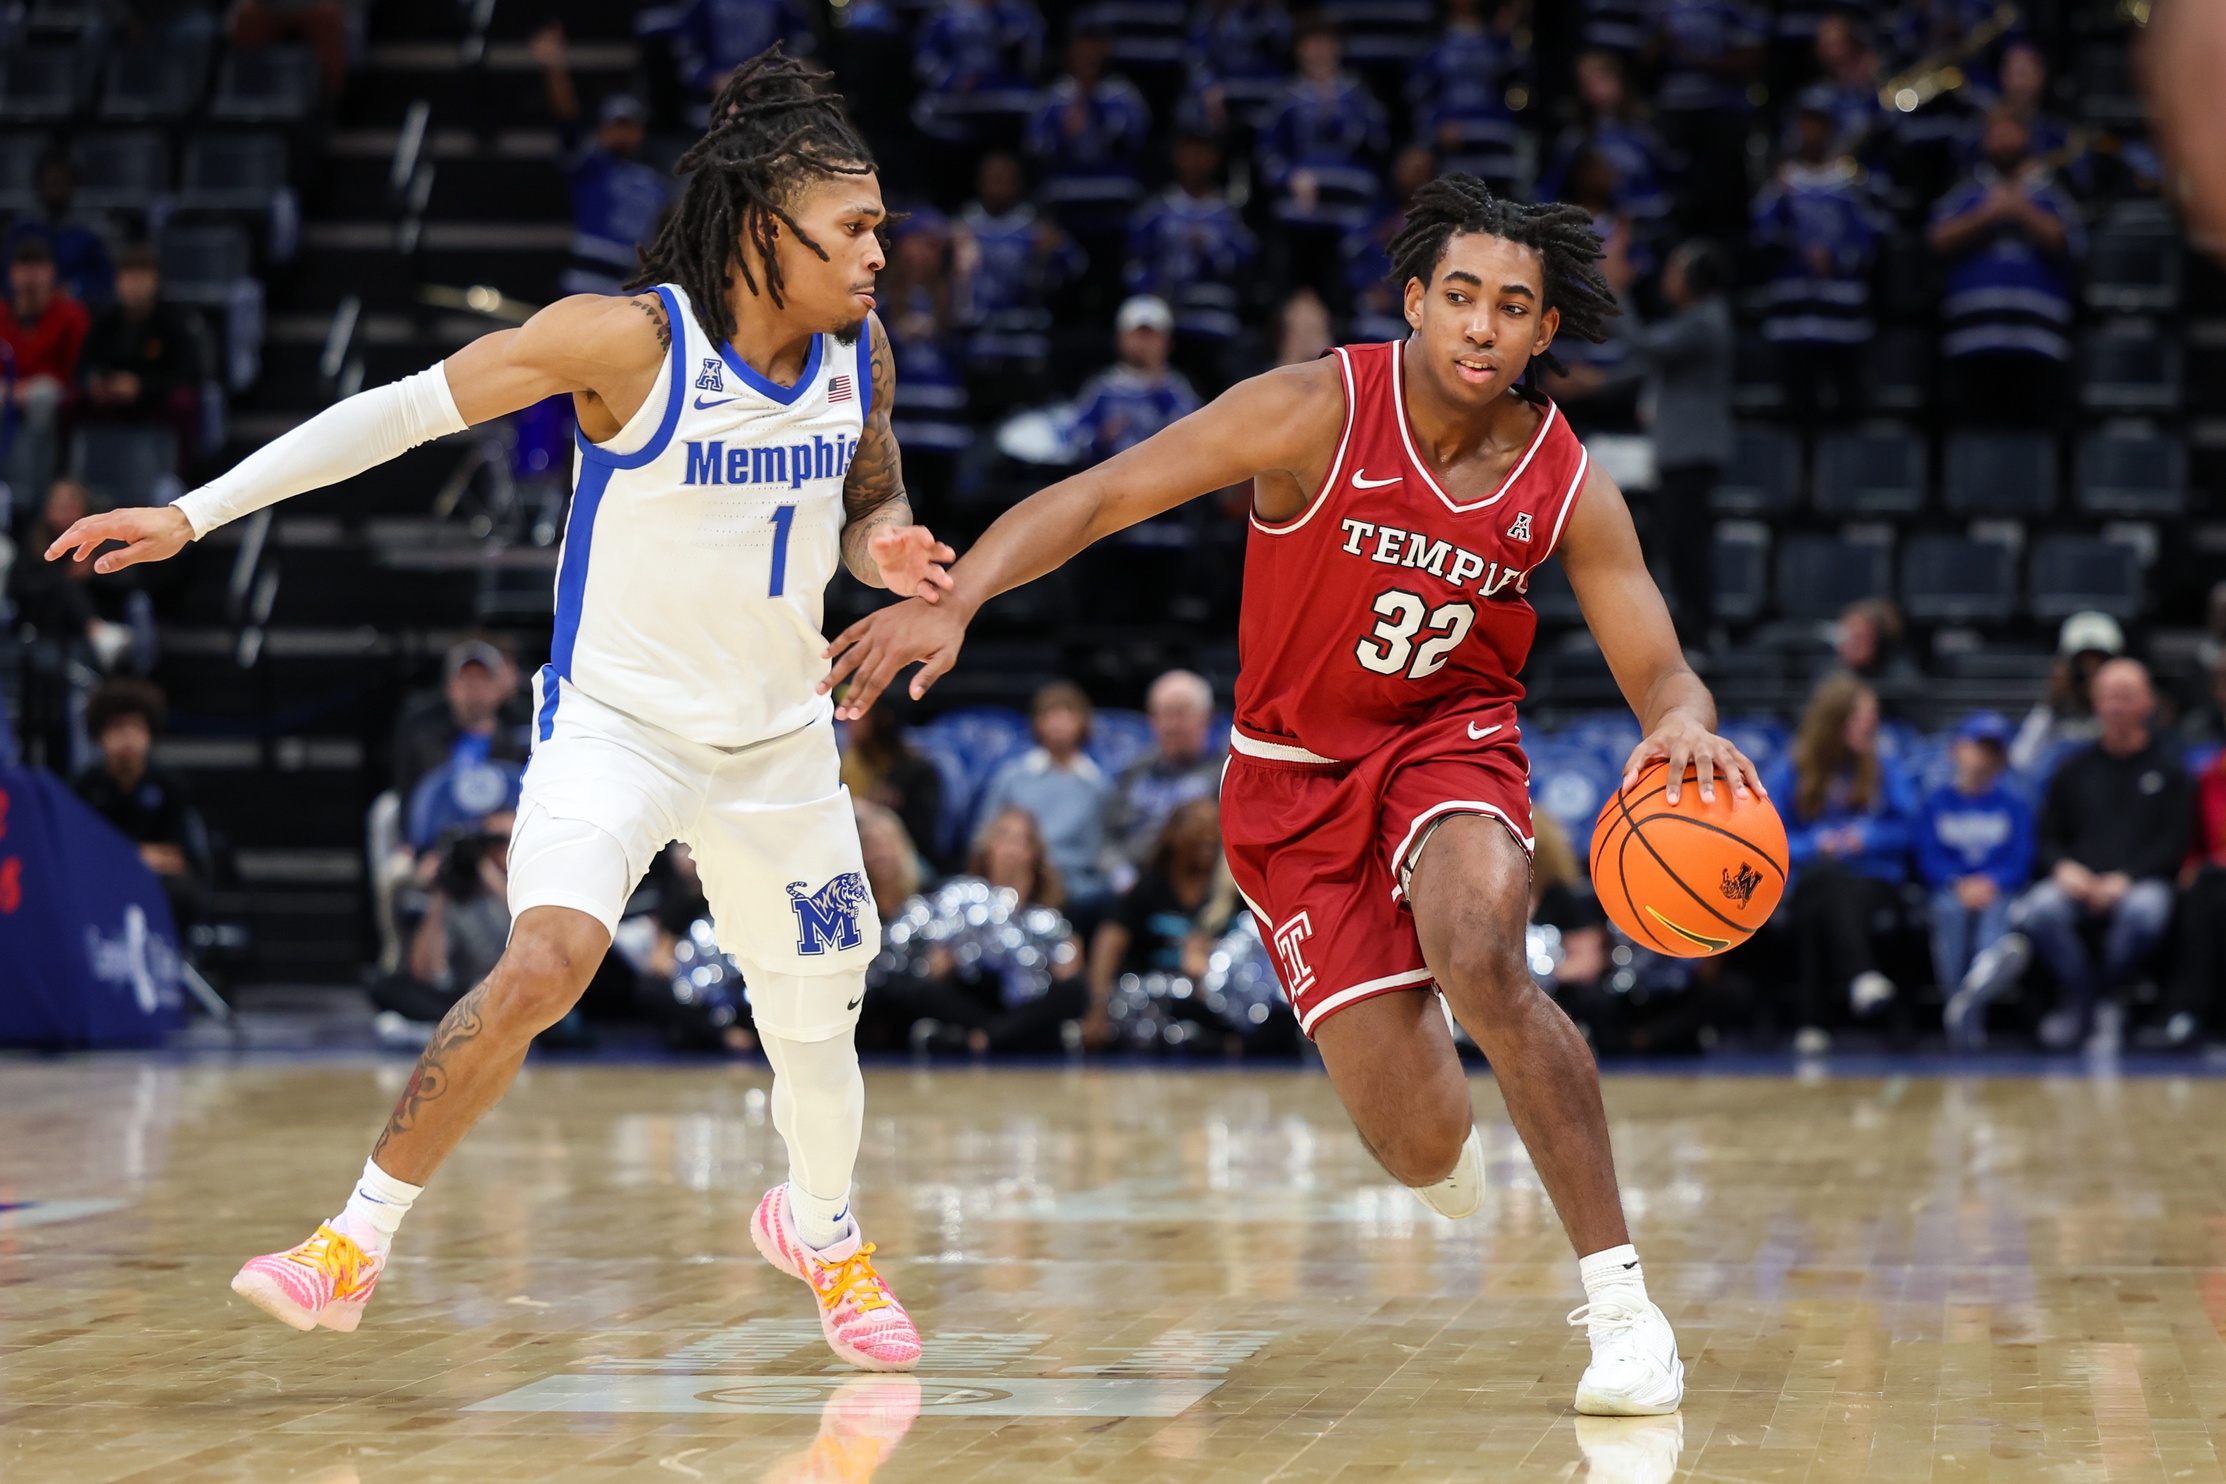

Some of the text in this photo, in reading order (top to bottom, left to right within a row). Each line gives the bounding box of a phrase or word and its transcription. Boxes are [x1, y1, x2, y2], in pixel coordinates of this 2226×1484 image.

[695, 358, 723, 392] A
[767, 504, 797, 599] 1
[1506, 511, 1533, 542] A
[1354, 586, 1477, 680] 32
[791, 897, 862, 956] M
[1274, 910, 1316, 998] T
